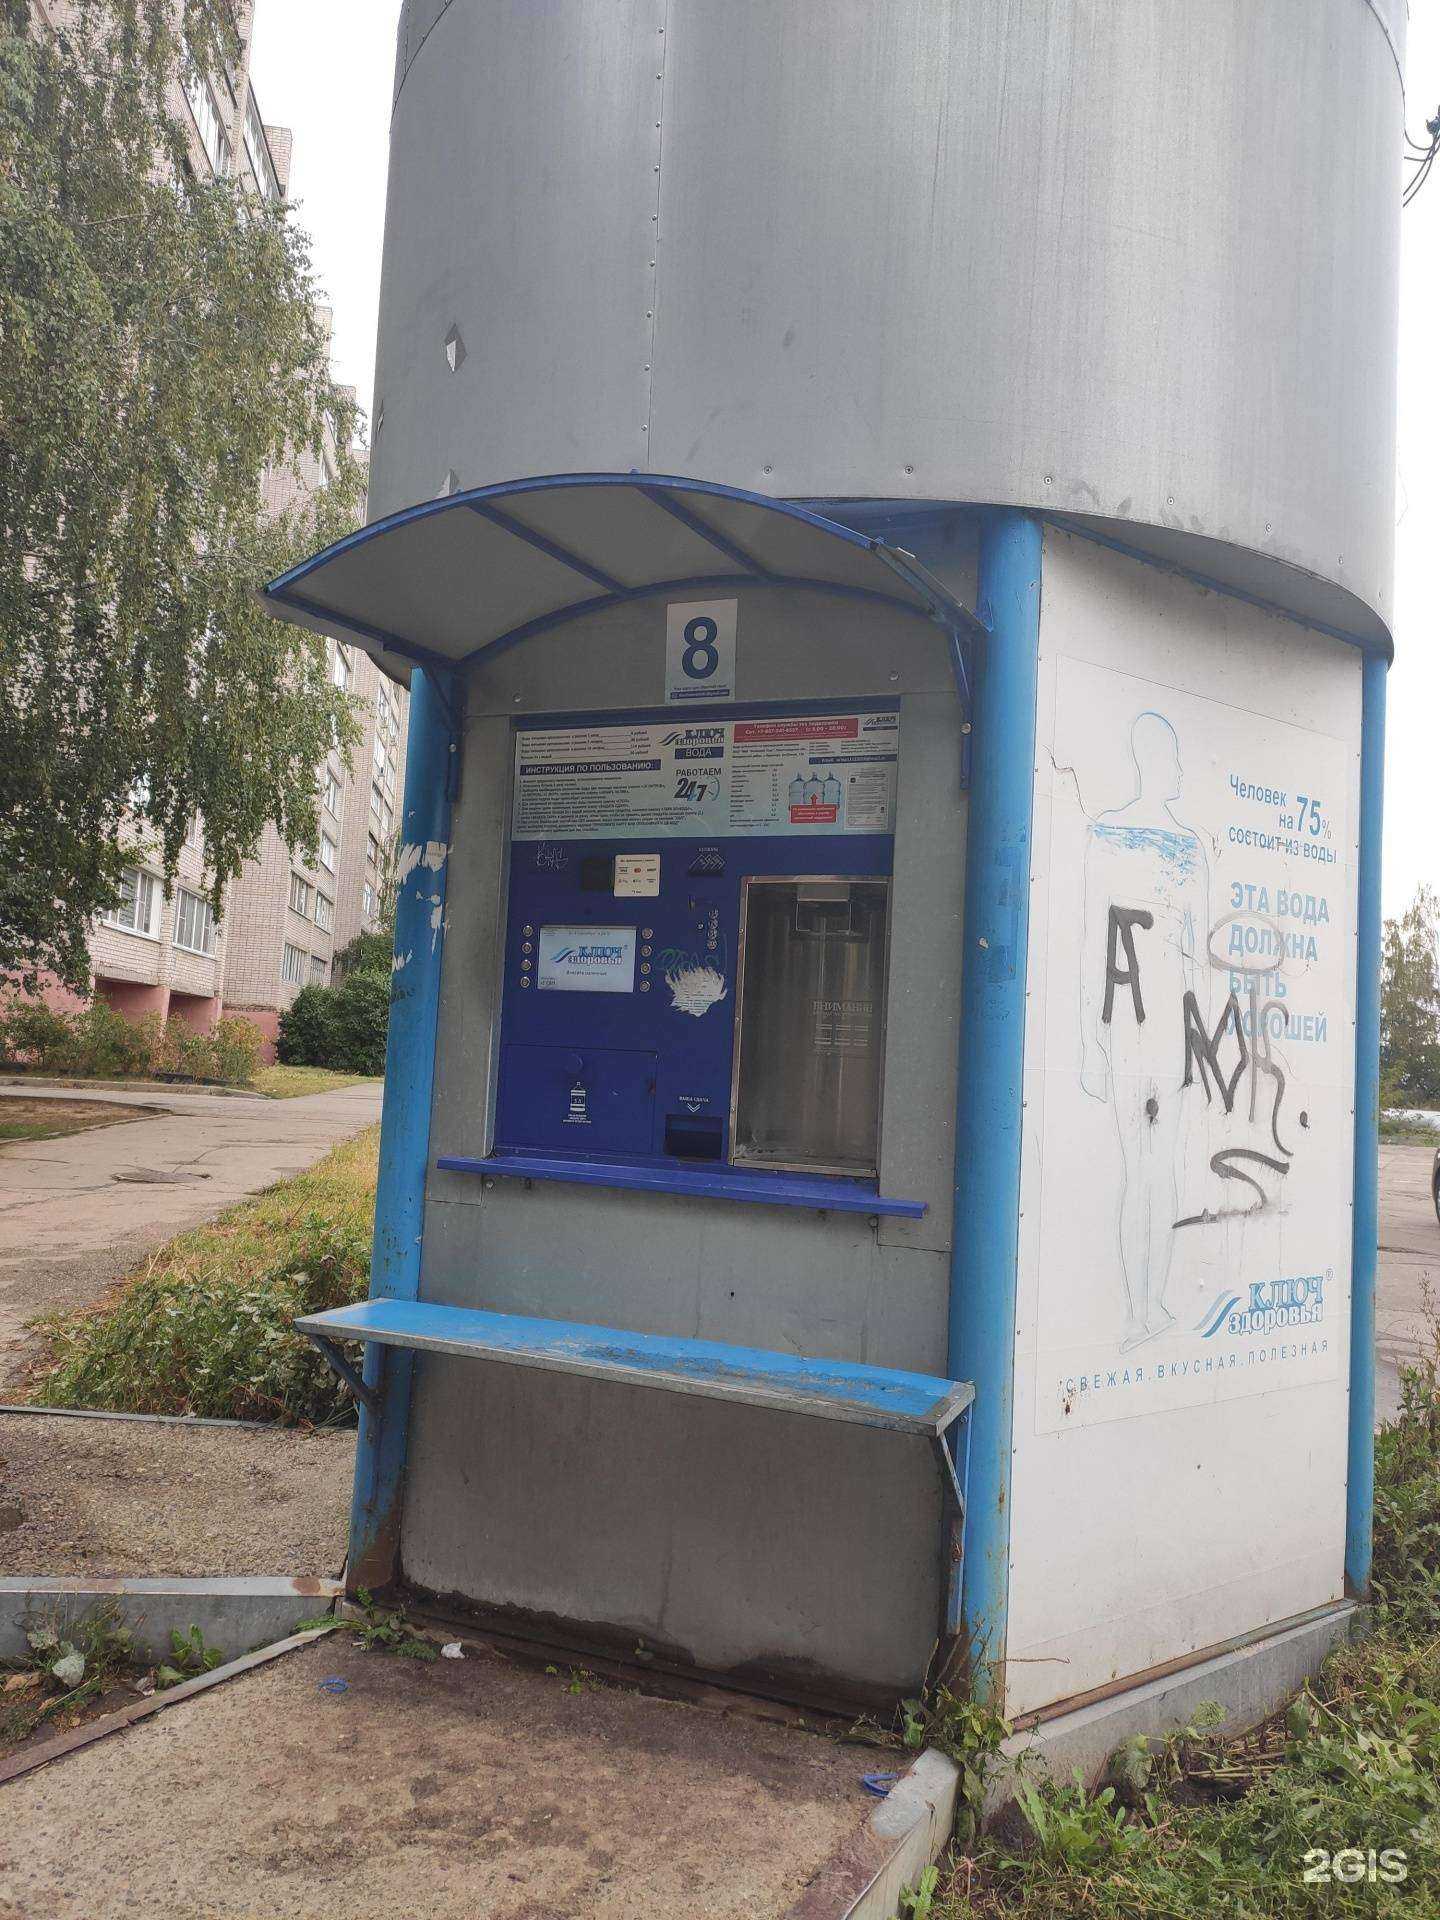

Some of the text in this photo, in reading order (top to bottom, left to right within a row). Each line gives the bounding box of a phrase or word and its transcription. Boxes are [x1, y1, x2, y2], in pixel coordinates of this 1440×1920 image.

[682, 616, 719, 680] 8
[686, 747, 712, 757] ВОДА
[525, 764, 575, 774] ИНСТРУКЦИЯ
[576, 763, 589, 773] ПО
[675, 767, 722, 777] РАБОТАЕМ
[1229, 773, 1288, 808] Человек
[1279, 811, 1294, 830] на
[1228, 825, 1338, 865] состоит из воды
[1230, 881, 1331, 926] ЭТА ВОДА
[1228, 924, 1319, 962] ДОЛЖНА
[1229, 968, 1288, 998] БЫТЬ
[1248, 1276, 1324, 1310] КЛЮЧ
[1248, 1339, 1330, 1367] ПОЛЕЗНАЯ
